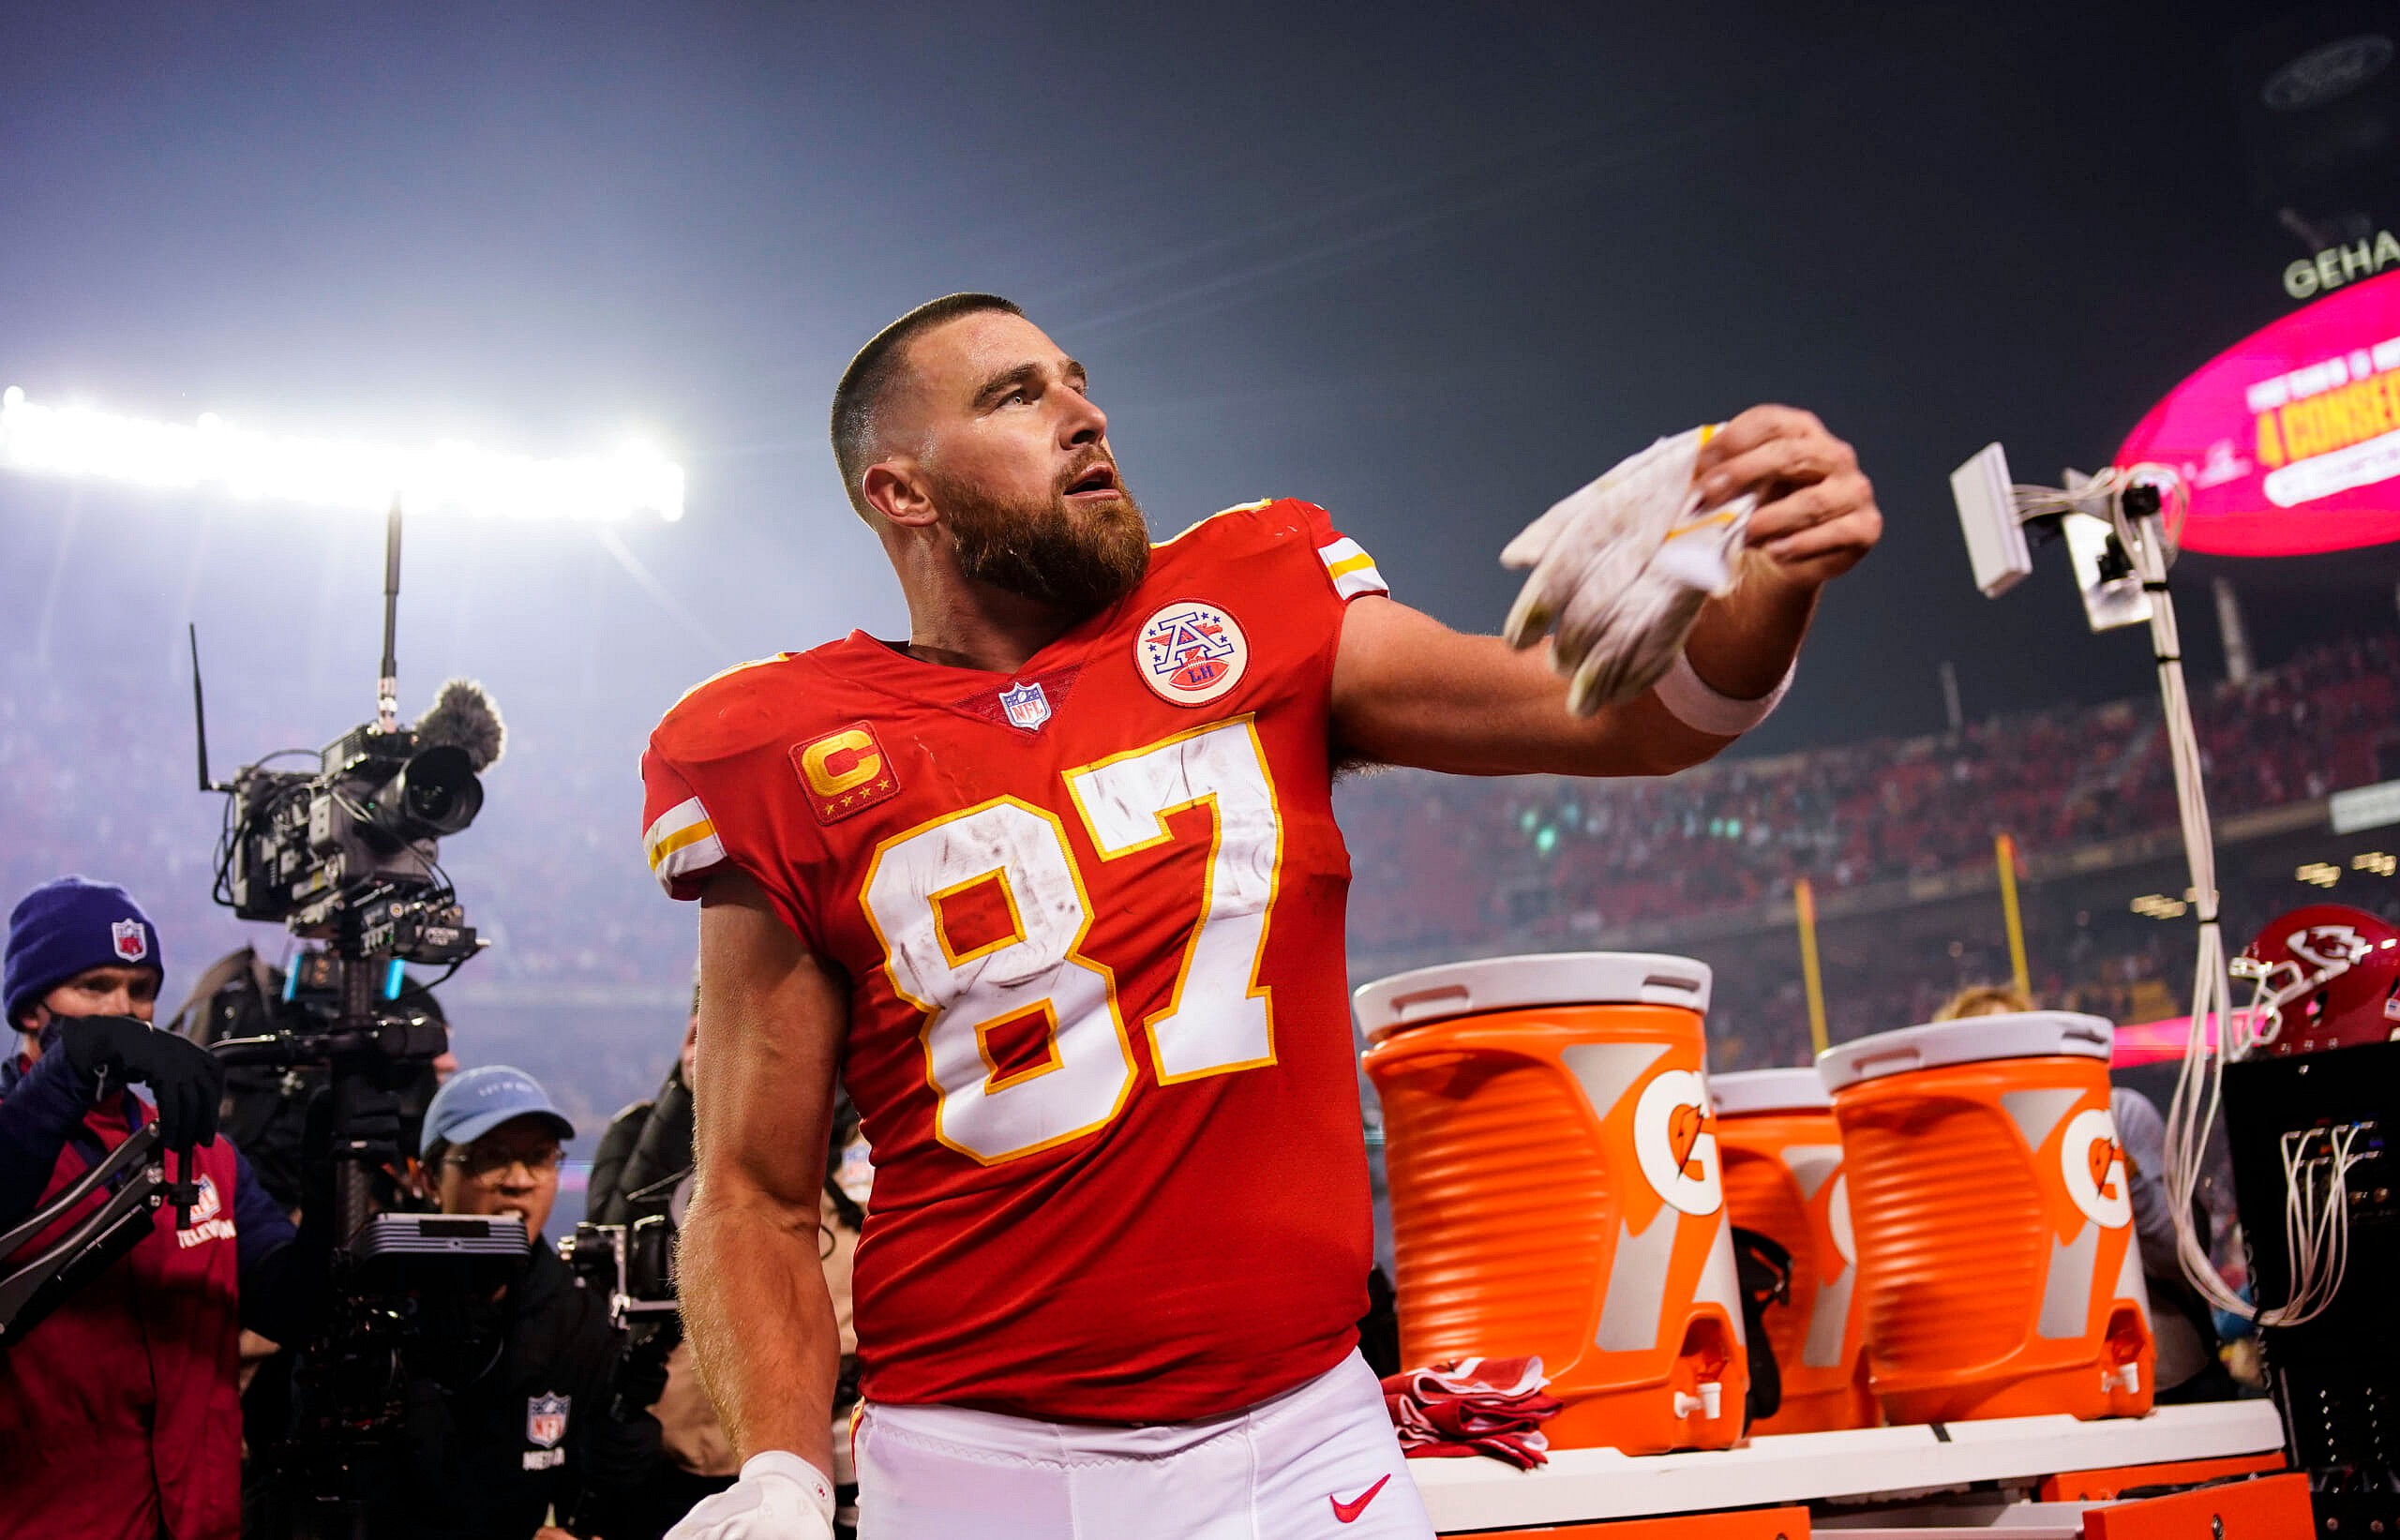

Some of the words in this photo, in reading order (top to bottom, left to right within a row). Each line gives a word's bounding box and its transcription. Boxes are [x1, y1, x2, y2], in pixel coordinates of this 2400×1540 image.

[2284, 230, 2400, 299] GEHA
[1153, 611, 1235, 675] A
[1188, 665, 1214, 683] LH
[1012, 700, 1043, 722] NFL
[802, 729, 881, 798] C
[859, 712, 1283, 1165] 87
[1634, 1069, 1723, 1216] G
[2062, 1109, 2133, 1229] G
